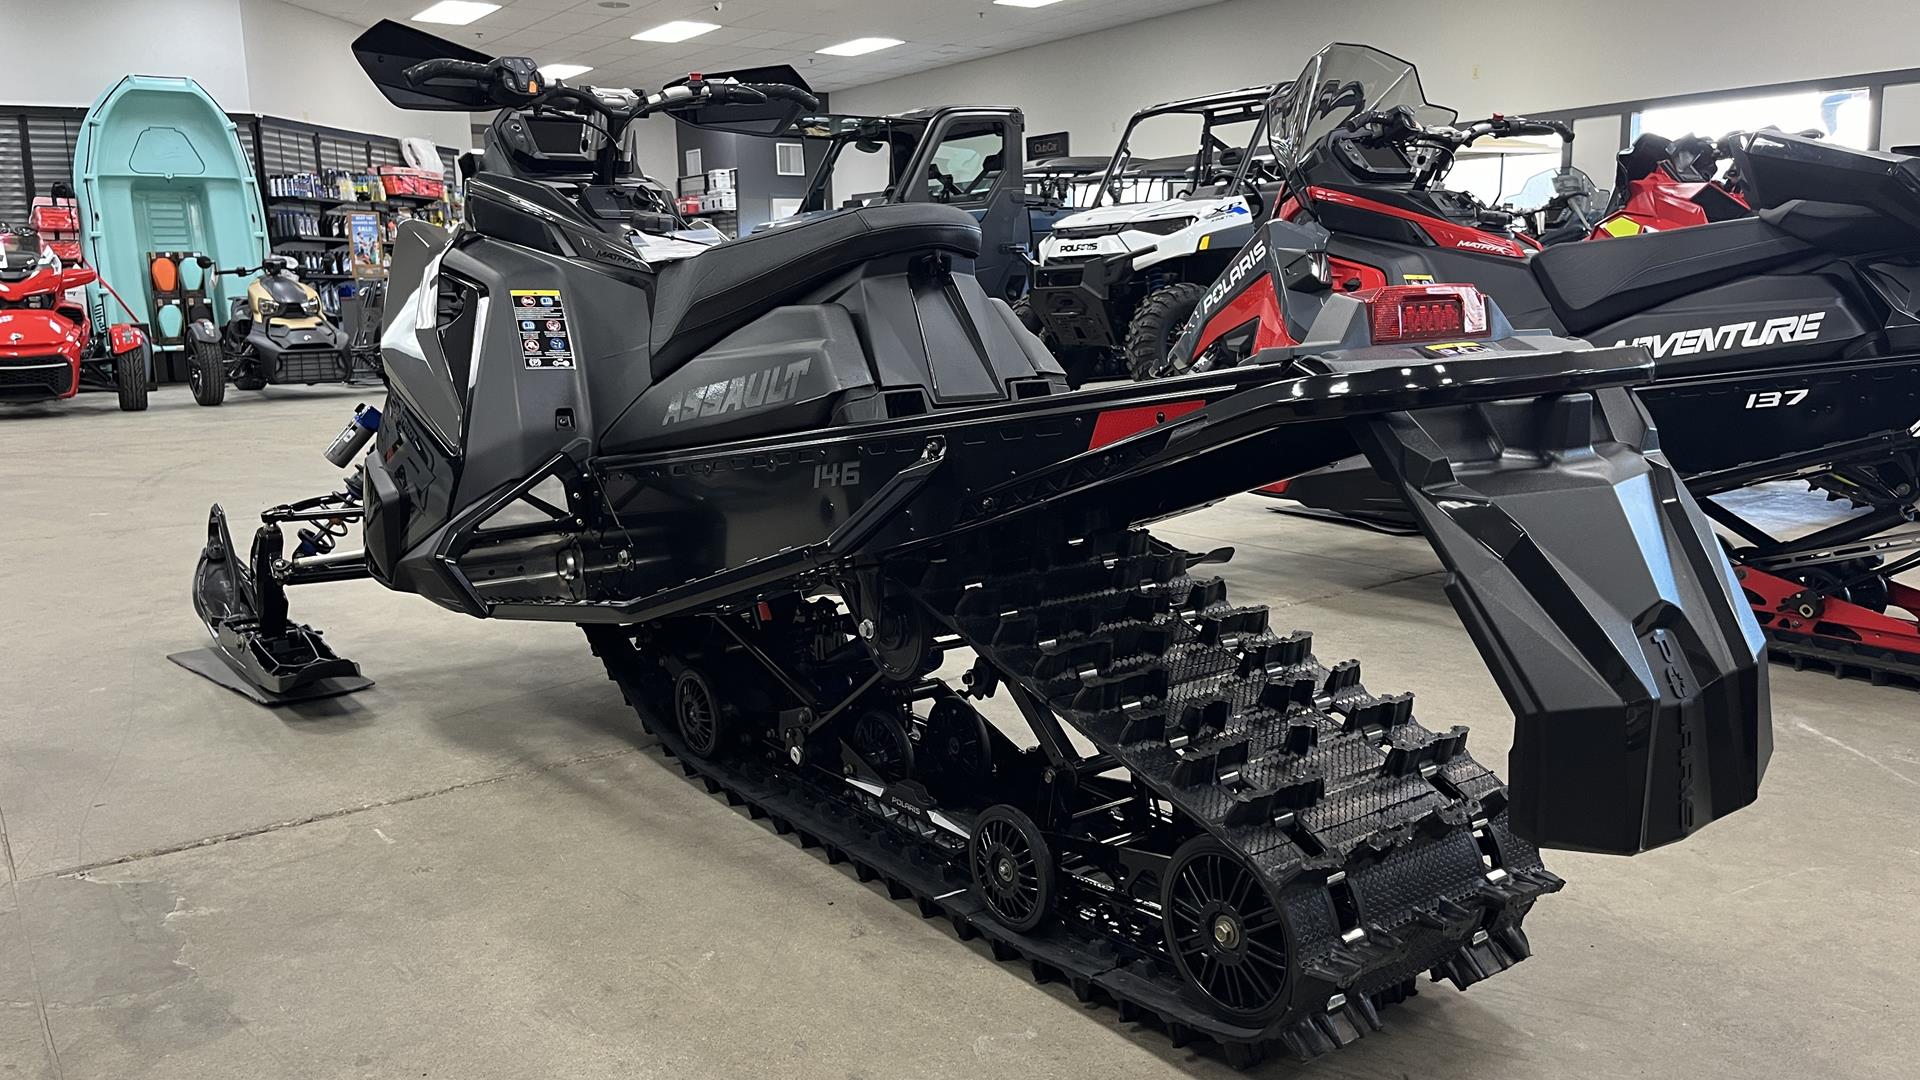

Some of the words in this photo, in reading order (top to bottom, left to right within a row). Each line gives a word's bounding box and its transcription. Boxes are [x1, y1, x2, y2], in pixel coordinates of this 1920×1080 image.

[1457, 240, 1508, 255] MATRYX
[1203, 239, 1267, 314] POLARIS
[662, 357, 812, 426] ASSAULT
[1745, 389, 1809, 409] 137
[813, 461, 861, 489] 146
[1650, 632, 1695, 834] POLARIS
[891, 796, 921, 815] POLARIS
